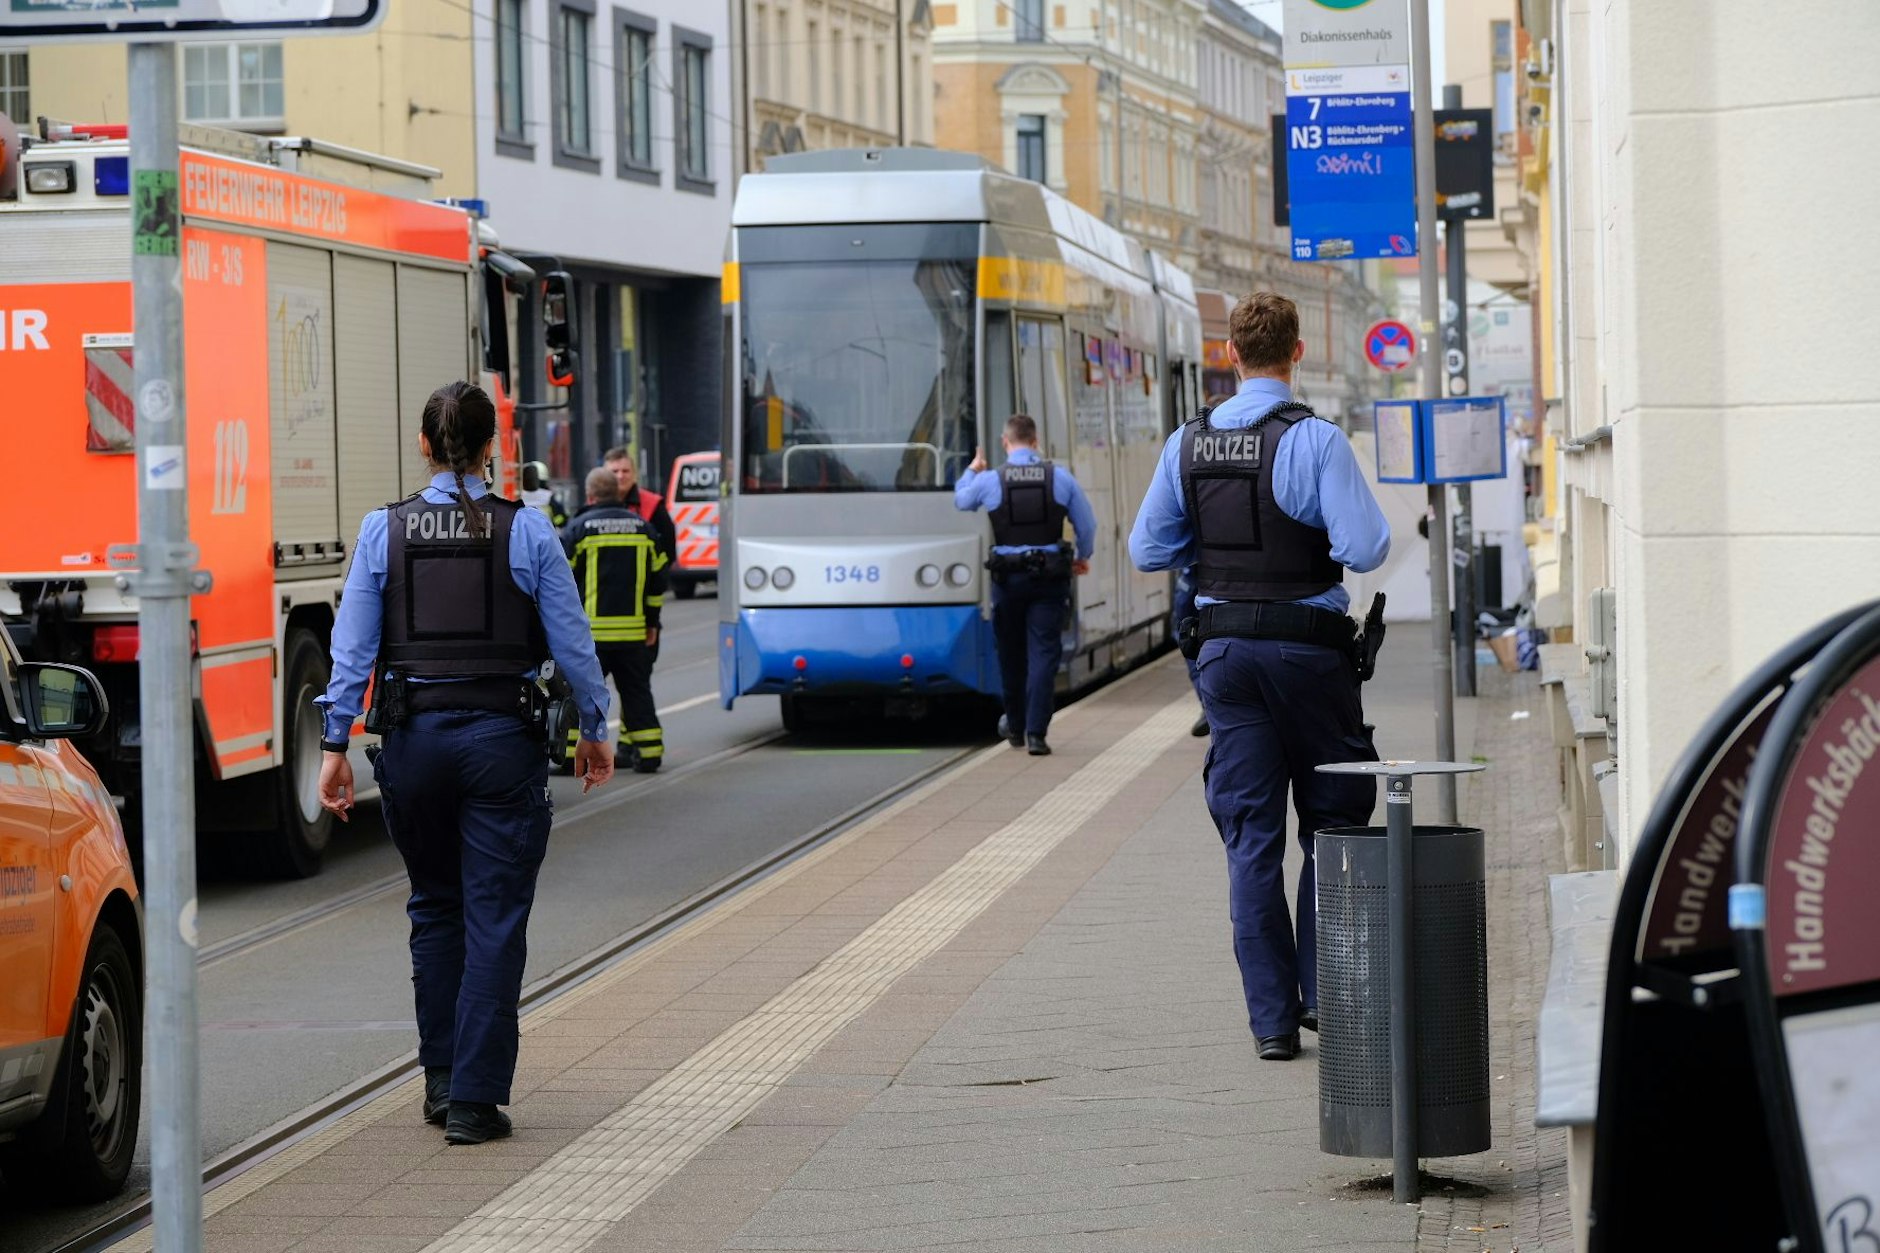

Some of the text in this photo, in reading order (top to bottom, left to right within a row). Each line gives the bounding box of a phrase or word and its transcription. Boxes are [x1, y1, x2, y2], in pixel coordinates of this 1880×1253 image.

[1300, 28, 1392, 43] Diakonissenhaus
[1303, 73, 1343, 83] Leipziger
[1307, 97, 1321, 120] 7
[1291, 125, 1322, 149] N3
[184, 160, 347, 235] FEUERWEHR LEIPZIG
[187, 239, 210, 282] RW
[1295, 246, 1312, 258] 110
[1193, 435, 1260, 462] POLIZEI
[211, 418, 249, 514] 112
[1005, 467, 1045, 481] POLIZEI
[406, 510, 492, 540] POLIZI
[598, 525, 637, 534] LEIPZIG
[825, 565, 880, 583] 1348
